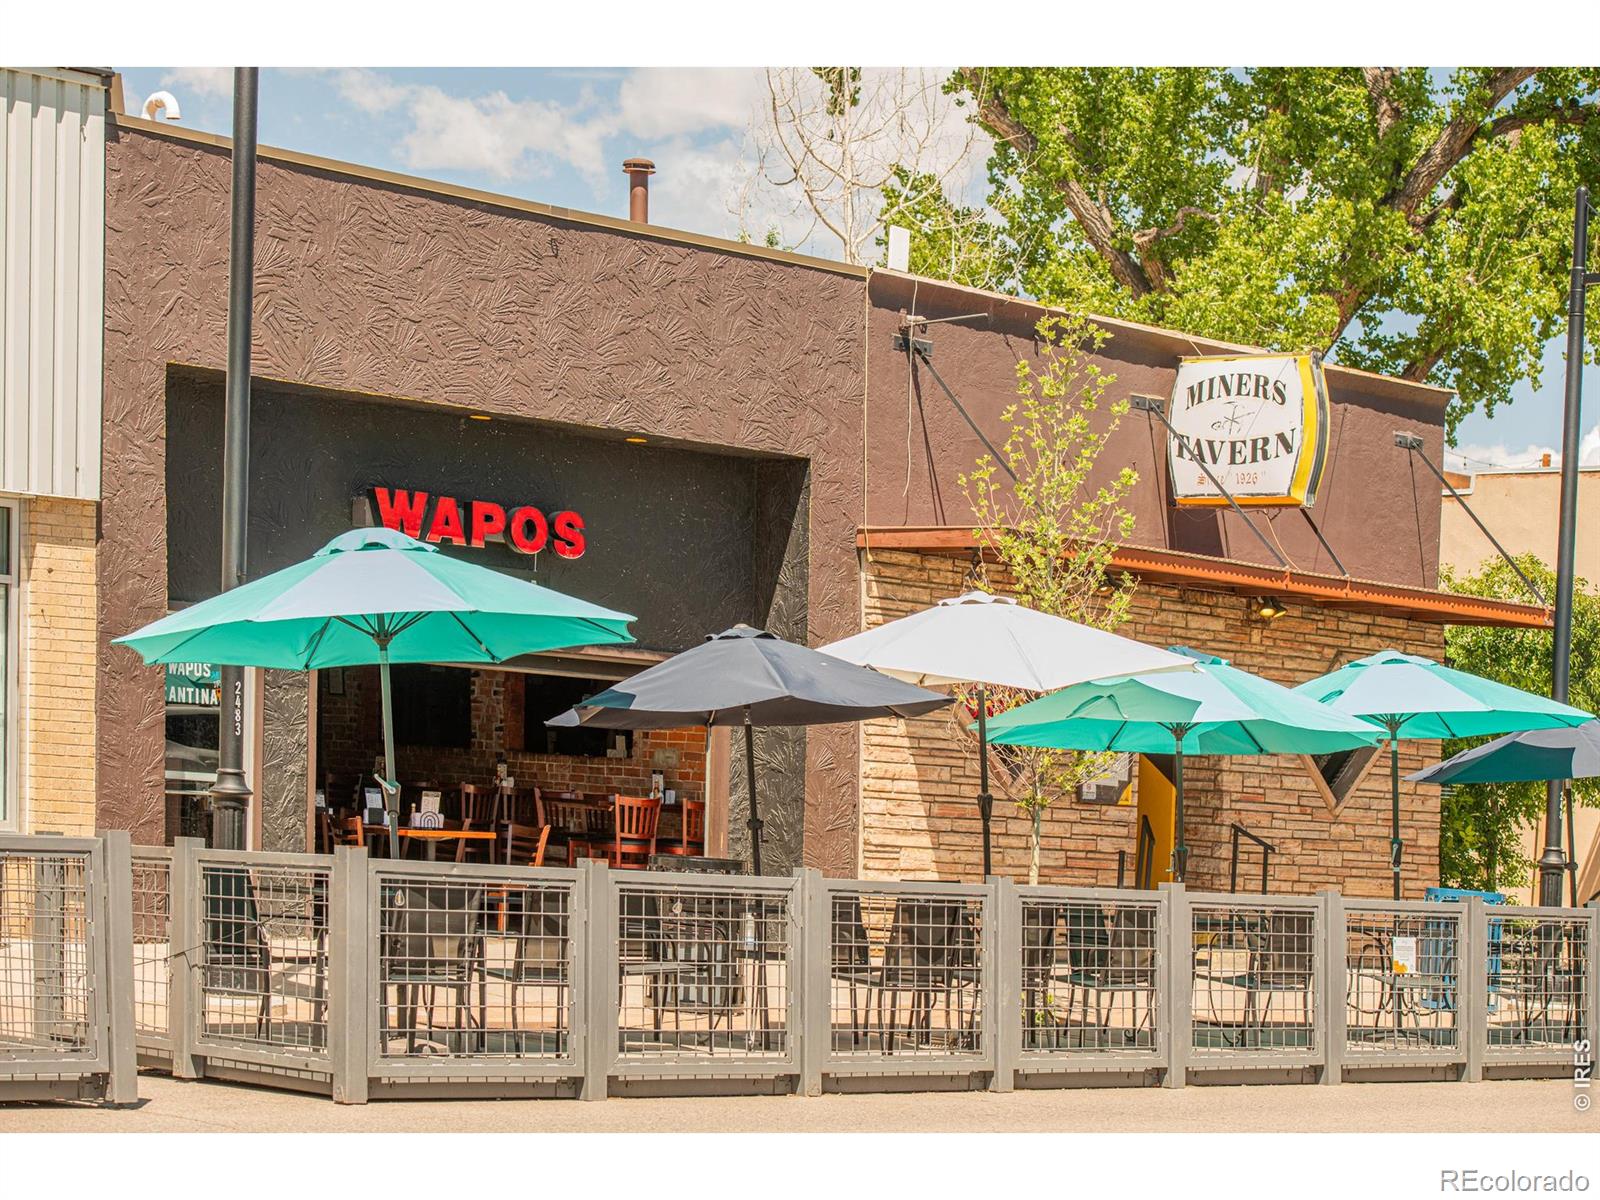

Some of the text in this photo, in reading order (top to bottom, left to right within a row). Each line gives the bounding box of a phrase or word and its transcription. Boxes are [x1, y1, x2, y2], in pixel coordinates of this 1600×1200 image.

[1185, 373, 1287, 412] MINERS
[1172, 427, 1297, 466] TAVERN
[373, 486, 587, 560] WAPOS
[165, 685, 219, 705] ANTINA
[234, 681, 242, 736] 2483
